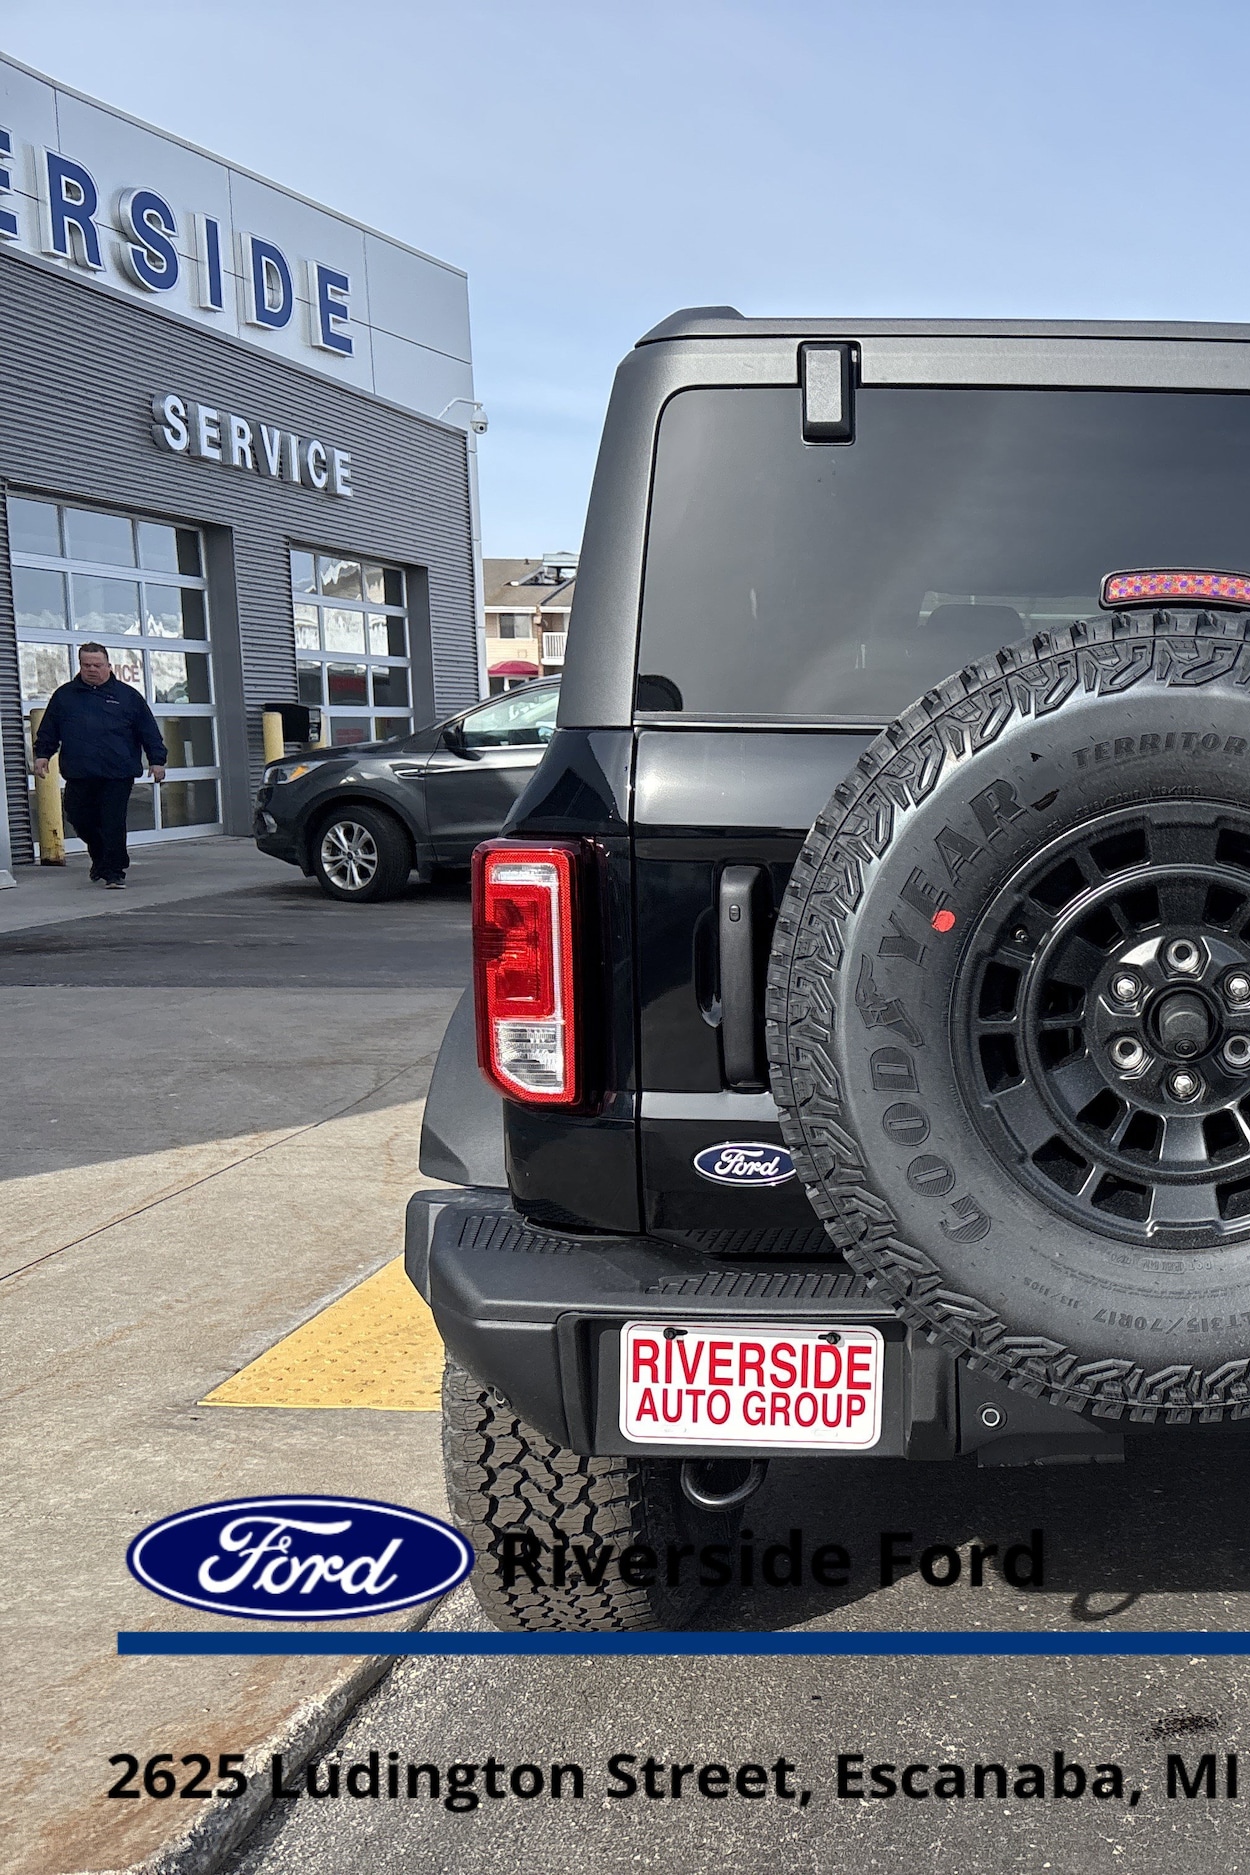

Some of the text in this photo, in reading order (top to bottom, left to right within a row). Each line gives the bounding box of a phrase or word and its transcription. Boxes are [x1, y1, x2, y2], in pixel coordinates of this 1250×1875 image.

[152, 392, 353, 498] SERVICE
[714, 1148, 780, 1177] Ford
[632, 1338, 873, 1391] RIVERSIDE
[636, 1387, 866, 1429] AUTO GROUP
